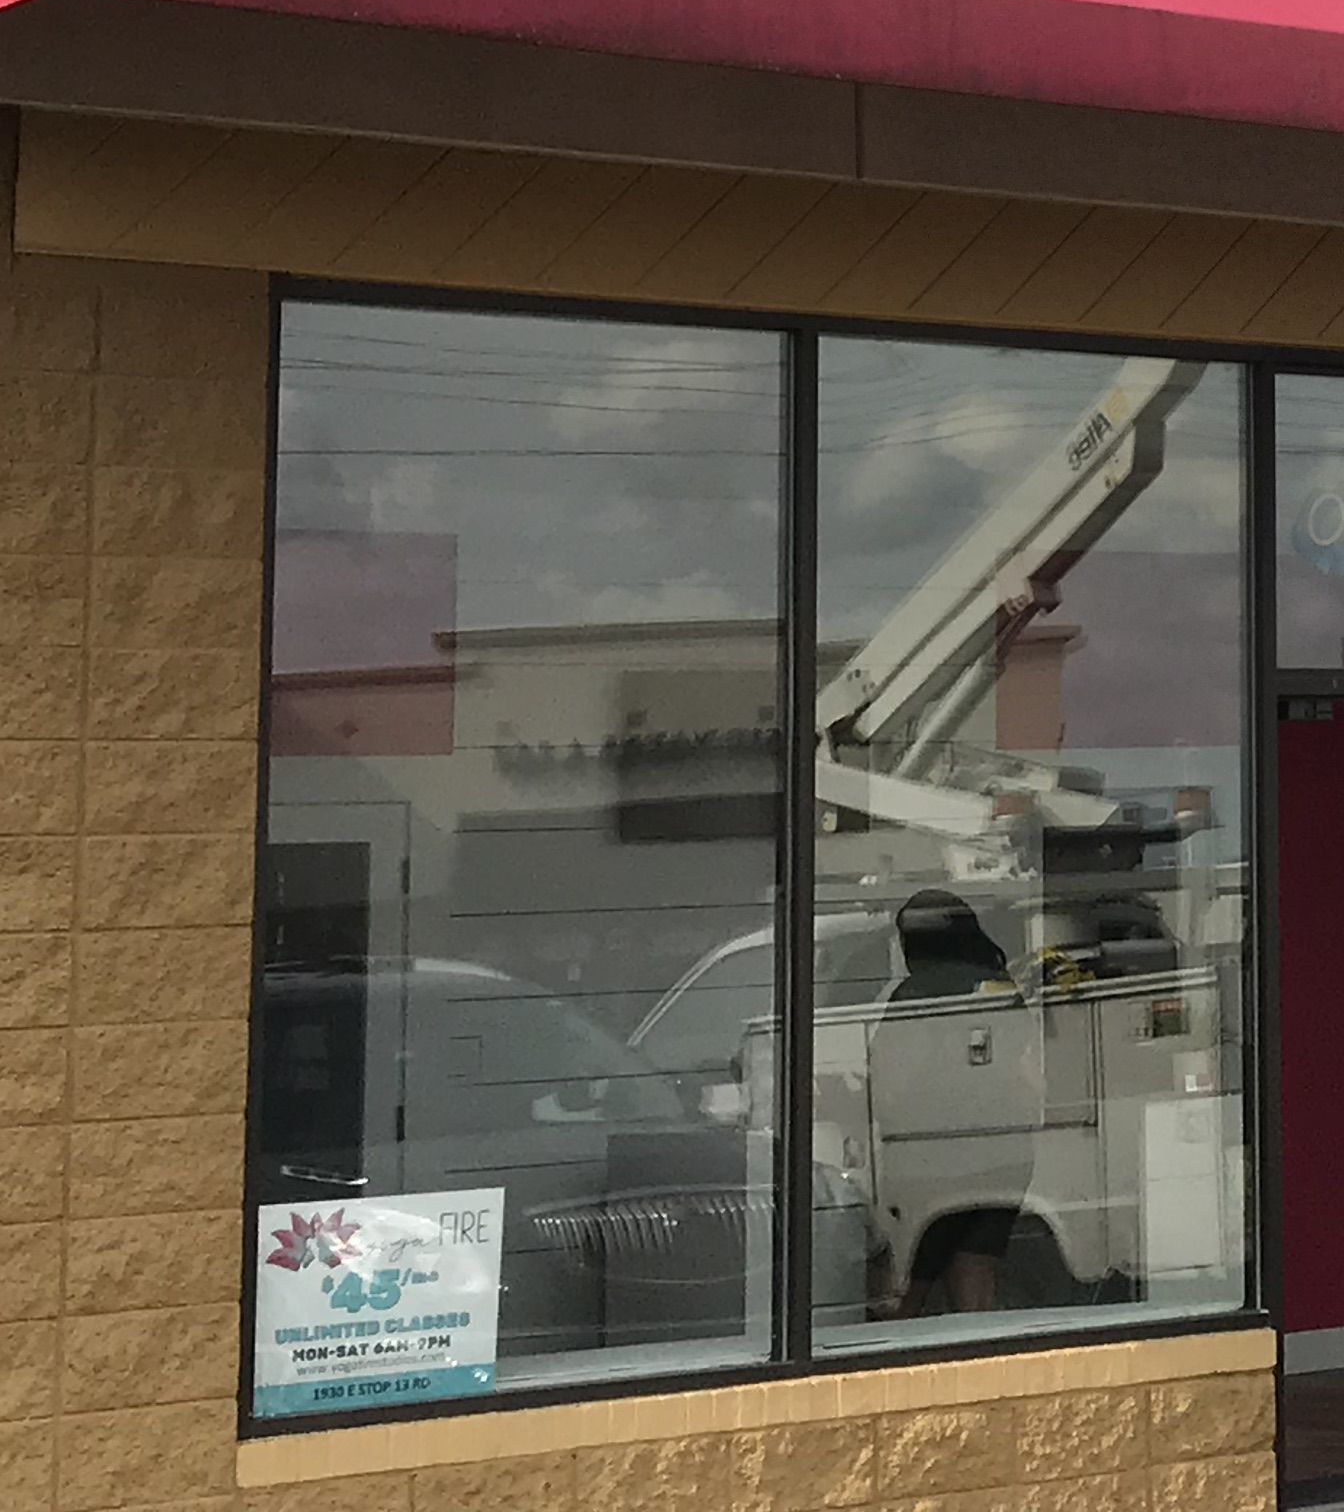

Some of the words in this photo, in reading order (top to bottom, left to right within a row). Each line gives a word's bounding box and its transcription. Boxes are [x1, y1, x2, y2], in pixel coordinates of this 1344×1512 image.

[439, 1209, 490, 1246] FIRE
[274, 1320, 380, 1345] UNLIMITED
[384, 1312, 471, 1334] CLASSES
[292, 1343, 370, 1362] MON-SAT
[347, 1383, 355, 1397] E
[358, 1380, 391, 1396] STOP
[412, 1377, 431, 1390] RD
